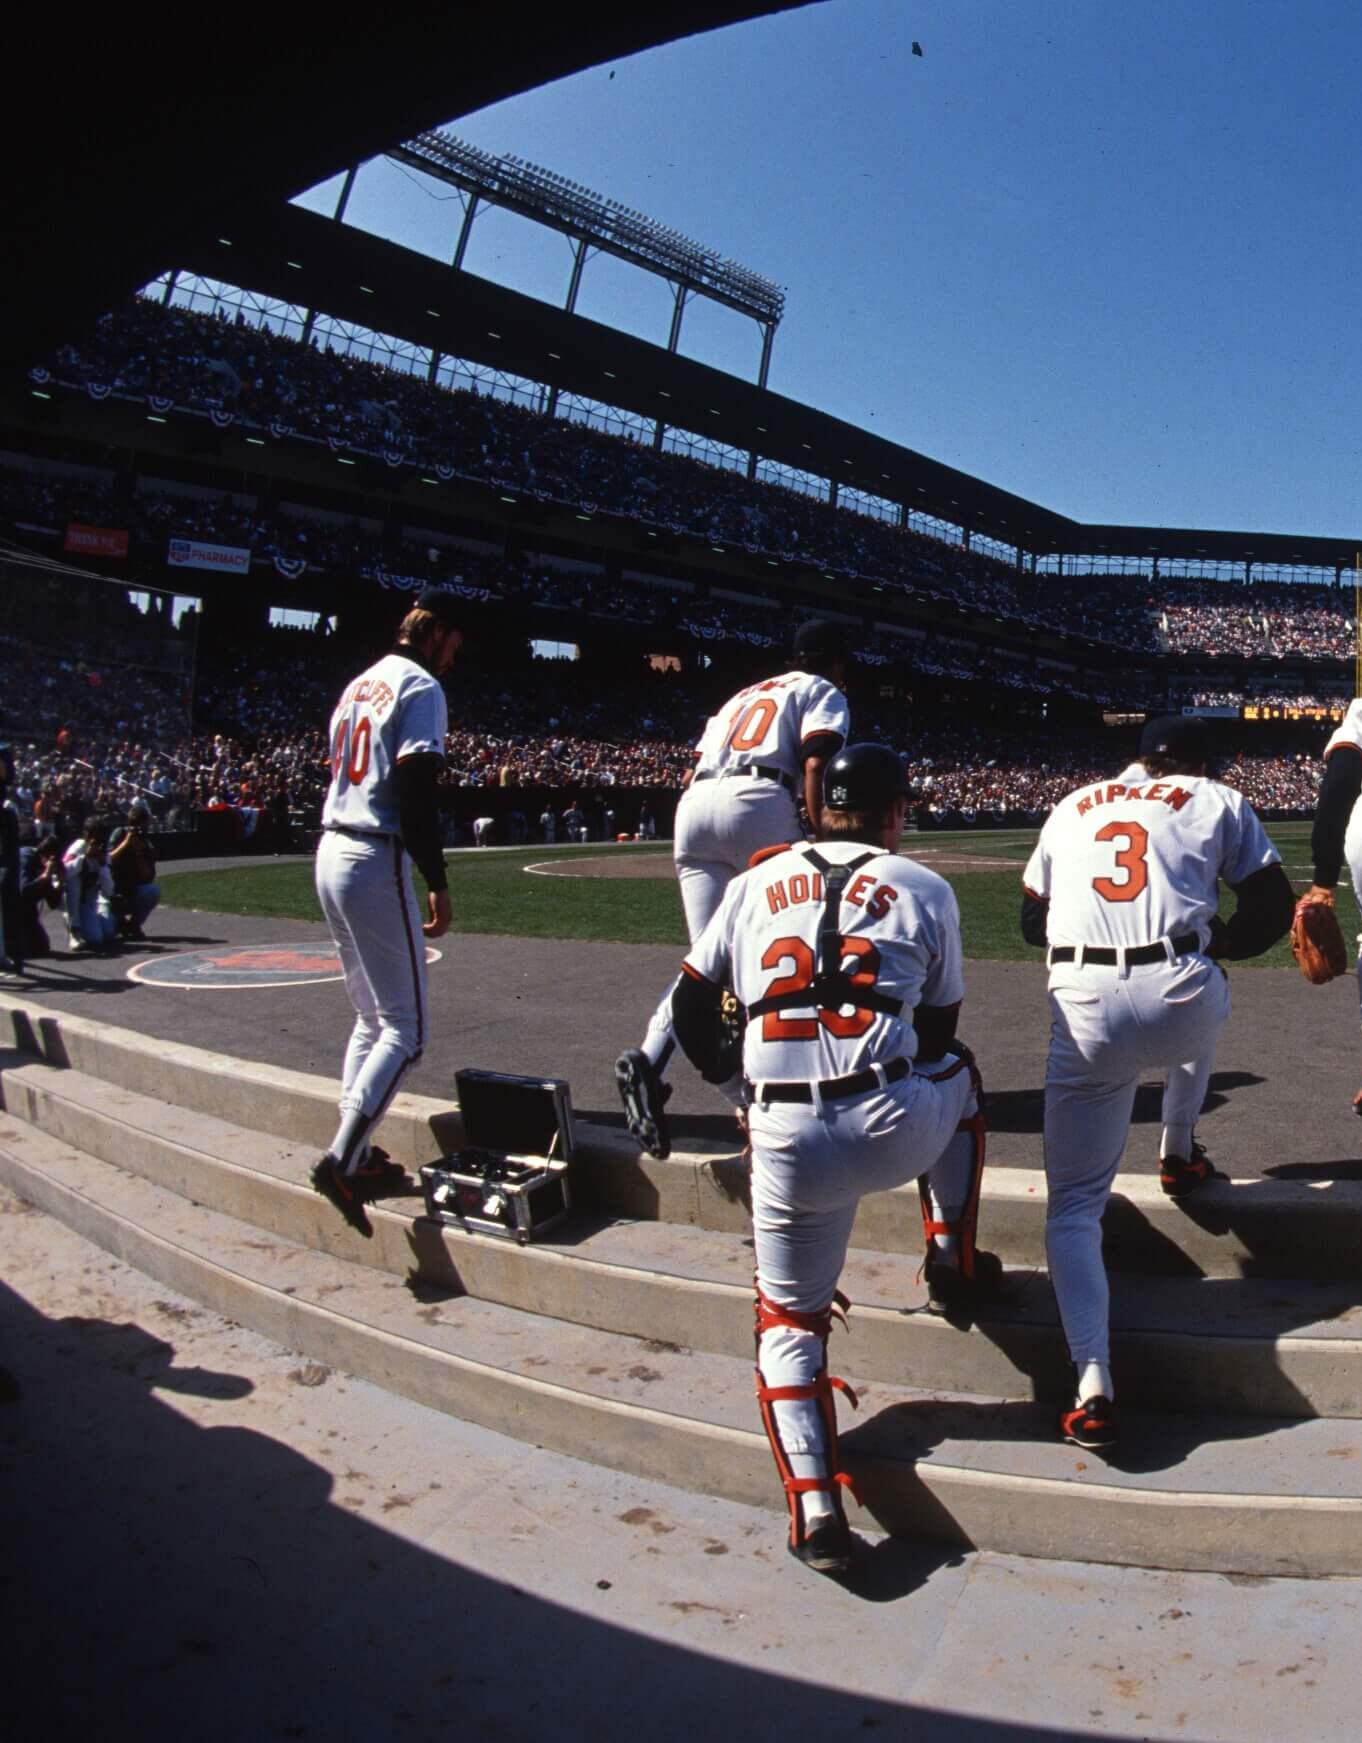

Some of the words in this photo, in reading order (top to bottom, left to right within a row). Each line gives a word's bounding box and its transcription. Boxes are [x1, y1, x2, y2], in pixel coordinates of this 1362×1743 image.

[192, 549, 247, 566] PHARMACY
[721, 698, 779, 752] 10
[1075, 783, 1195, 817] RIPKEN
[1092, 820, 1150, 903] 3
[766, 872, 899, 920] HOIES
